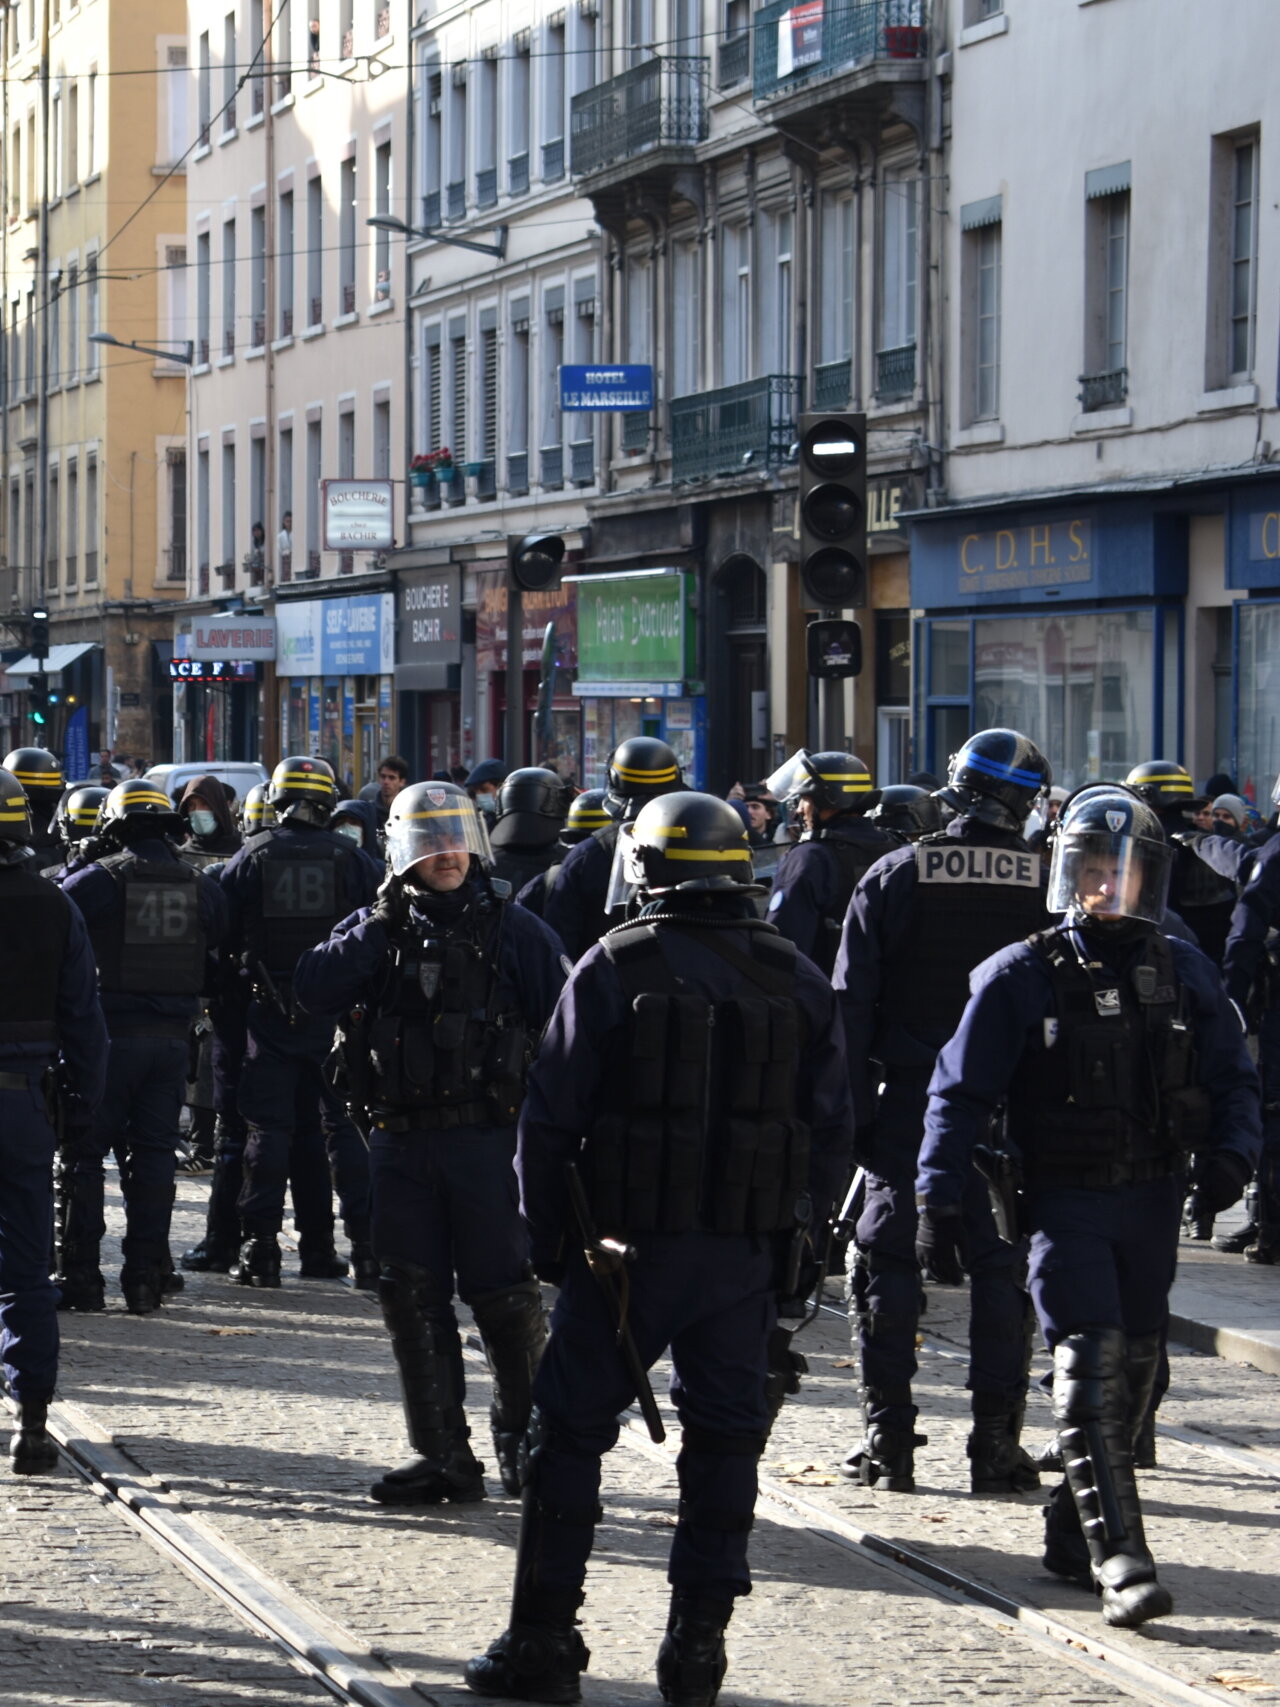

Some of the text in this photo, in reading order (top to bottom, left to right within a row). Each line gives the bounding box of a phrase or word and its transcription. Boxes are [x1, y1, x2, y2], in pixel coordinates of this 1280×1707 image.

[585, 372, 626, 384] HOTEL
[564, 391, 650, 406] LE MARSEILLE
[330, 490, 387, 507] BOUCHERIE
[341, 532, 377, 540] BACHIR
[405, 584, 449, 610] BOUCHERIE
[413, 618, 440, 642] BACHIR
[596, 595, 625, 646] Palais
[631, 596, 680, 648] Exotique
[196, 628, 274, 648] LAVERIE
[925, 850, 1032, 882] POLICE
[136, 890, 189, 938] 4B
